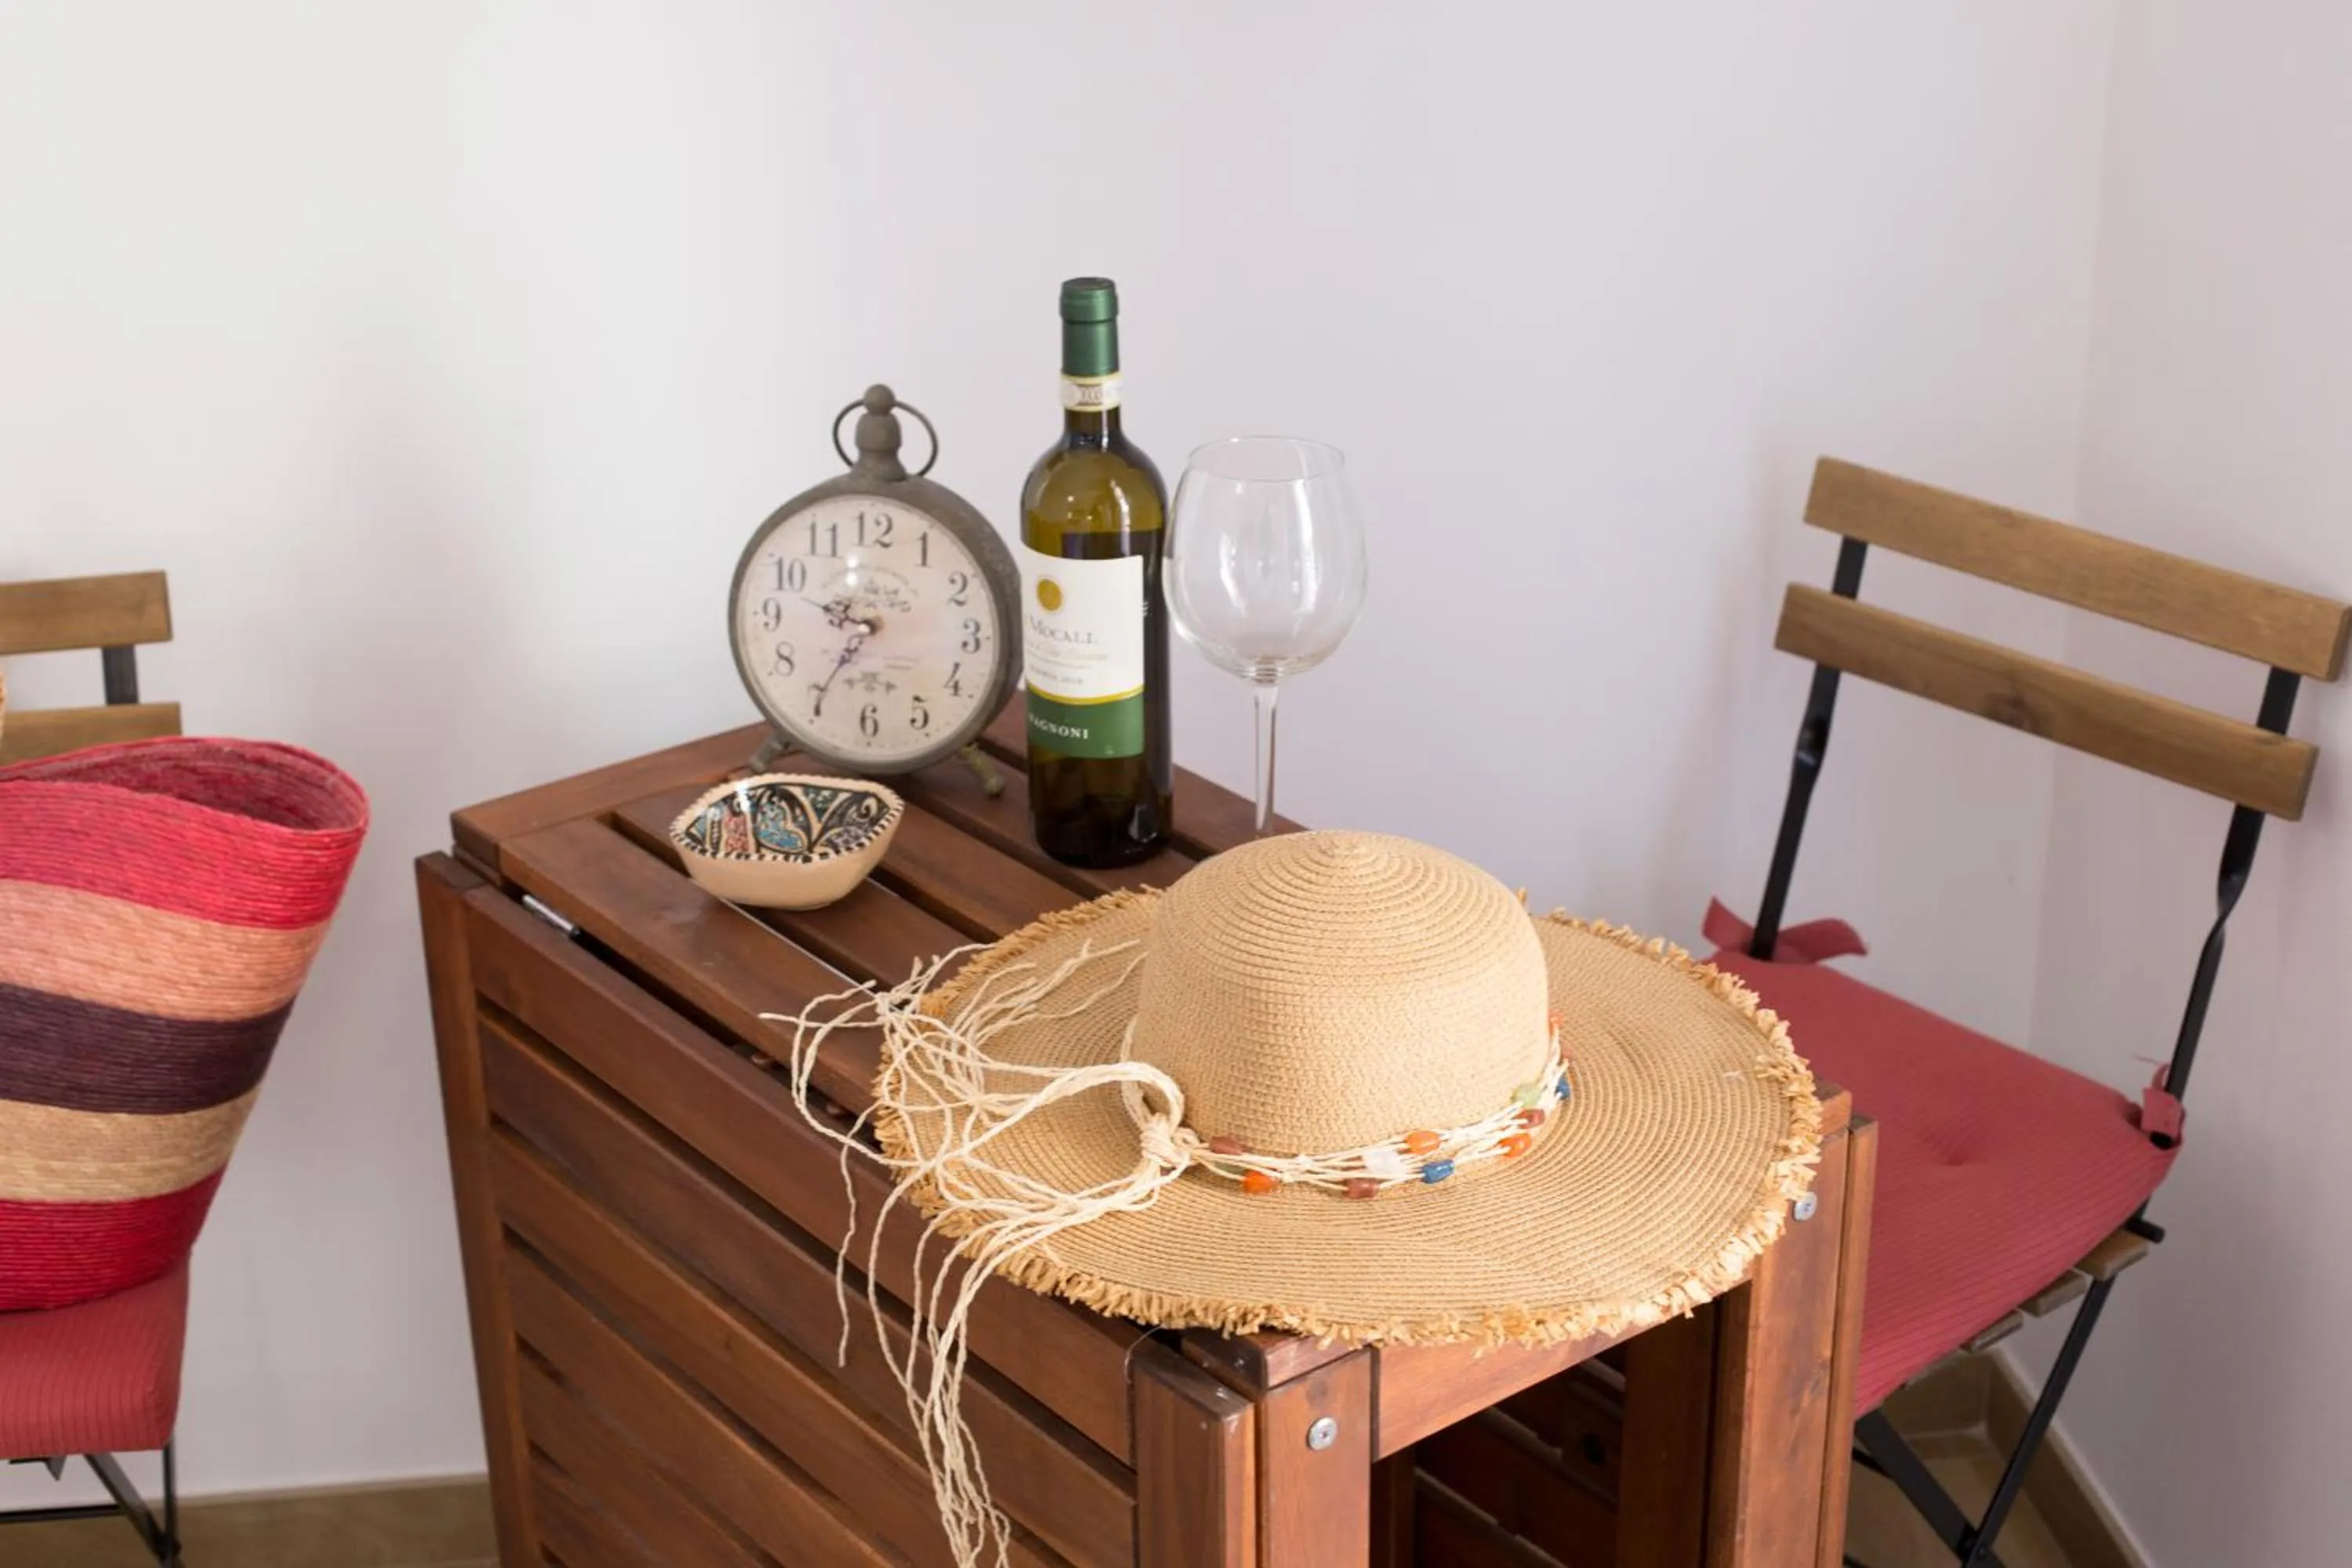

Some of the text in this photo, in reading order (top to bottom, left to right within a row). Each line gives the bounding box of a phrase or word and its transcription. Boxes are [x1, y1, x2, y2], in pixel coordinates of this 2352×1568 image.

[804, 519, 843, 558] 11
[854, 510, 895, 549] 12
[916, 532, 934, 568] 1
[772, 556, 807, 592] 10
[948, 572, 969, 607] 2
[762, 597, 782, 633] 9
[961, 618, 982, 654] 3
[775, 641, 795, 677] 8
[943, 662, 963, 698] 4
[808, 682, 826, 717] 7
[910, 695, 930, 730] 5
[860, 703, 880, 739] 6
